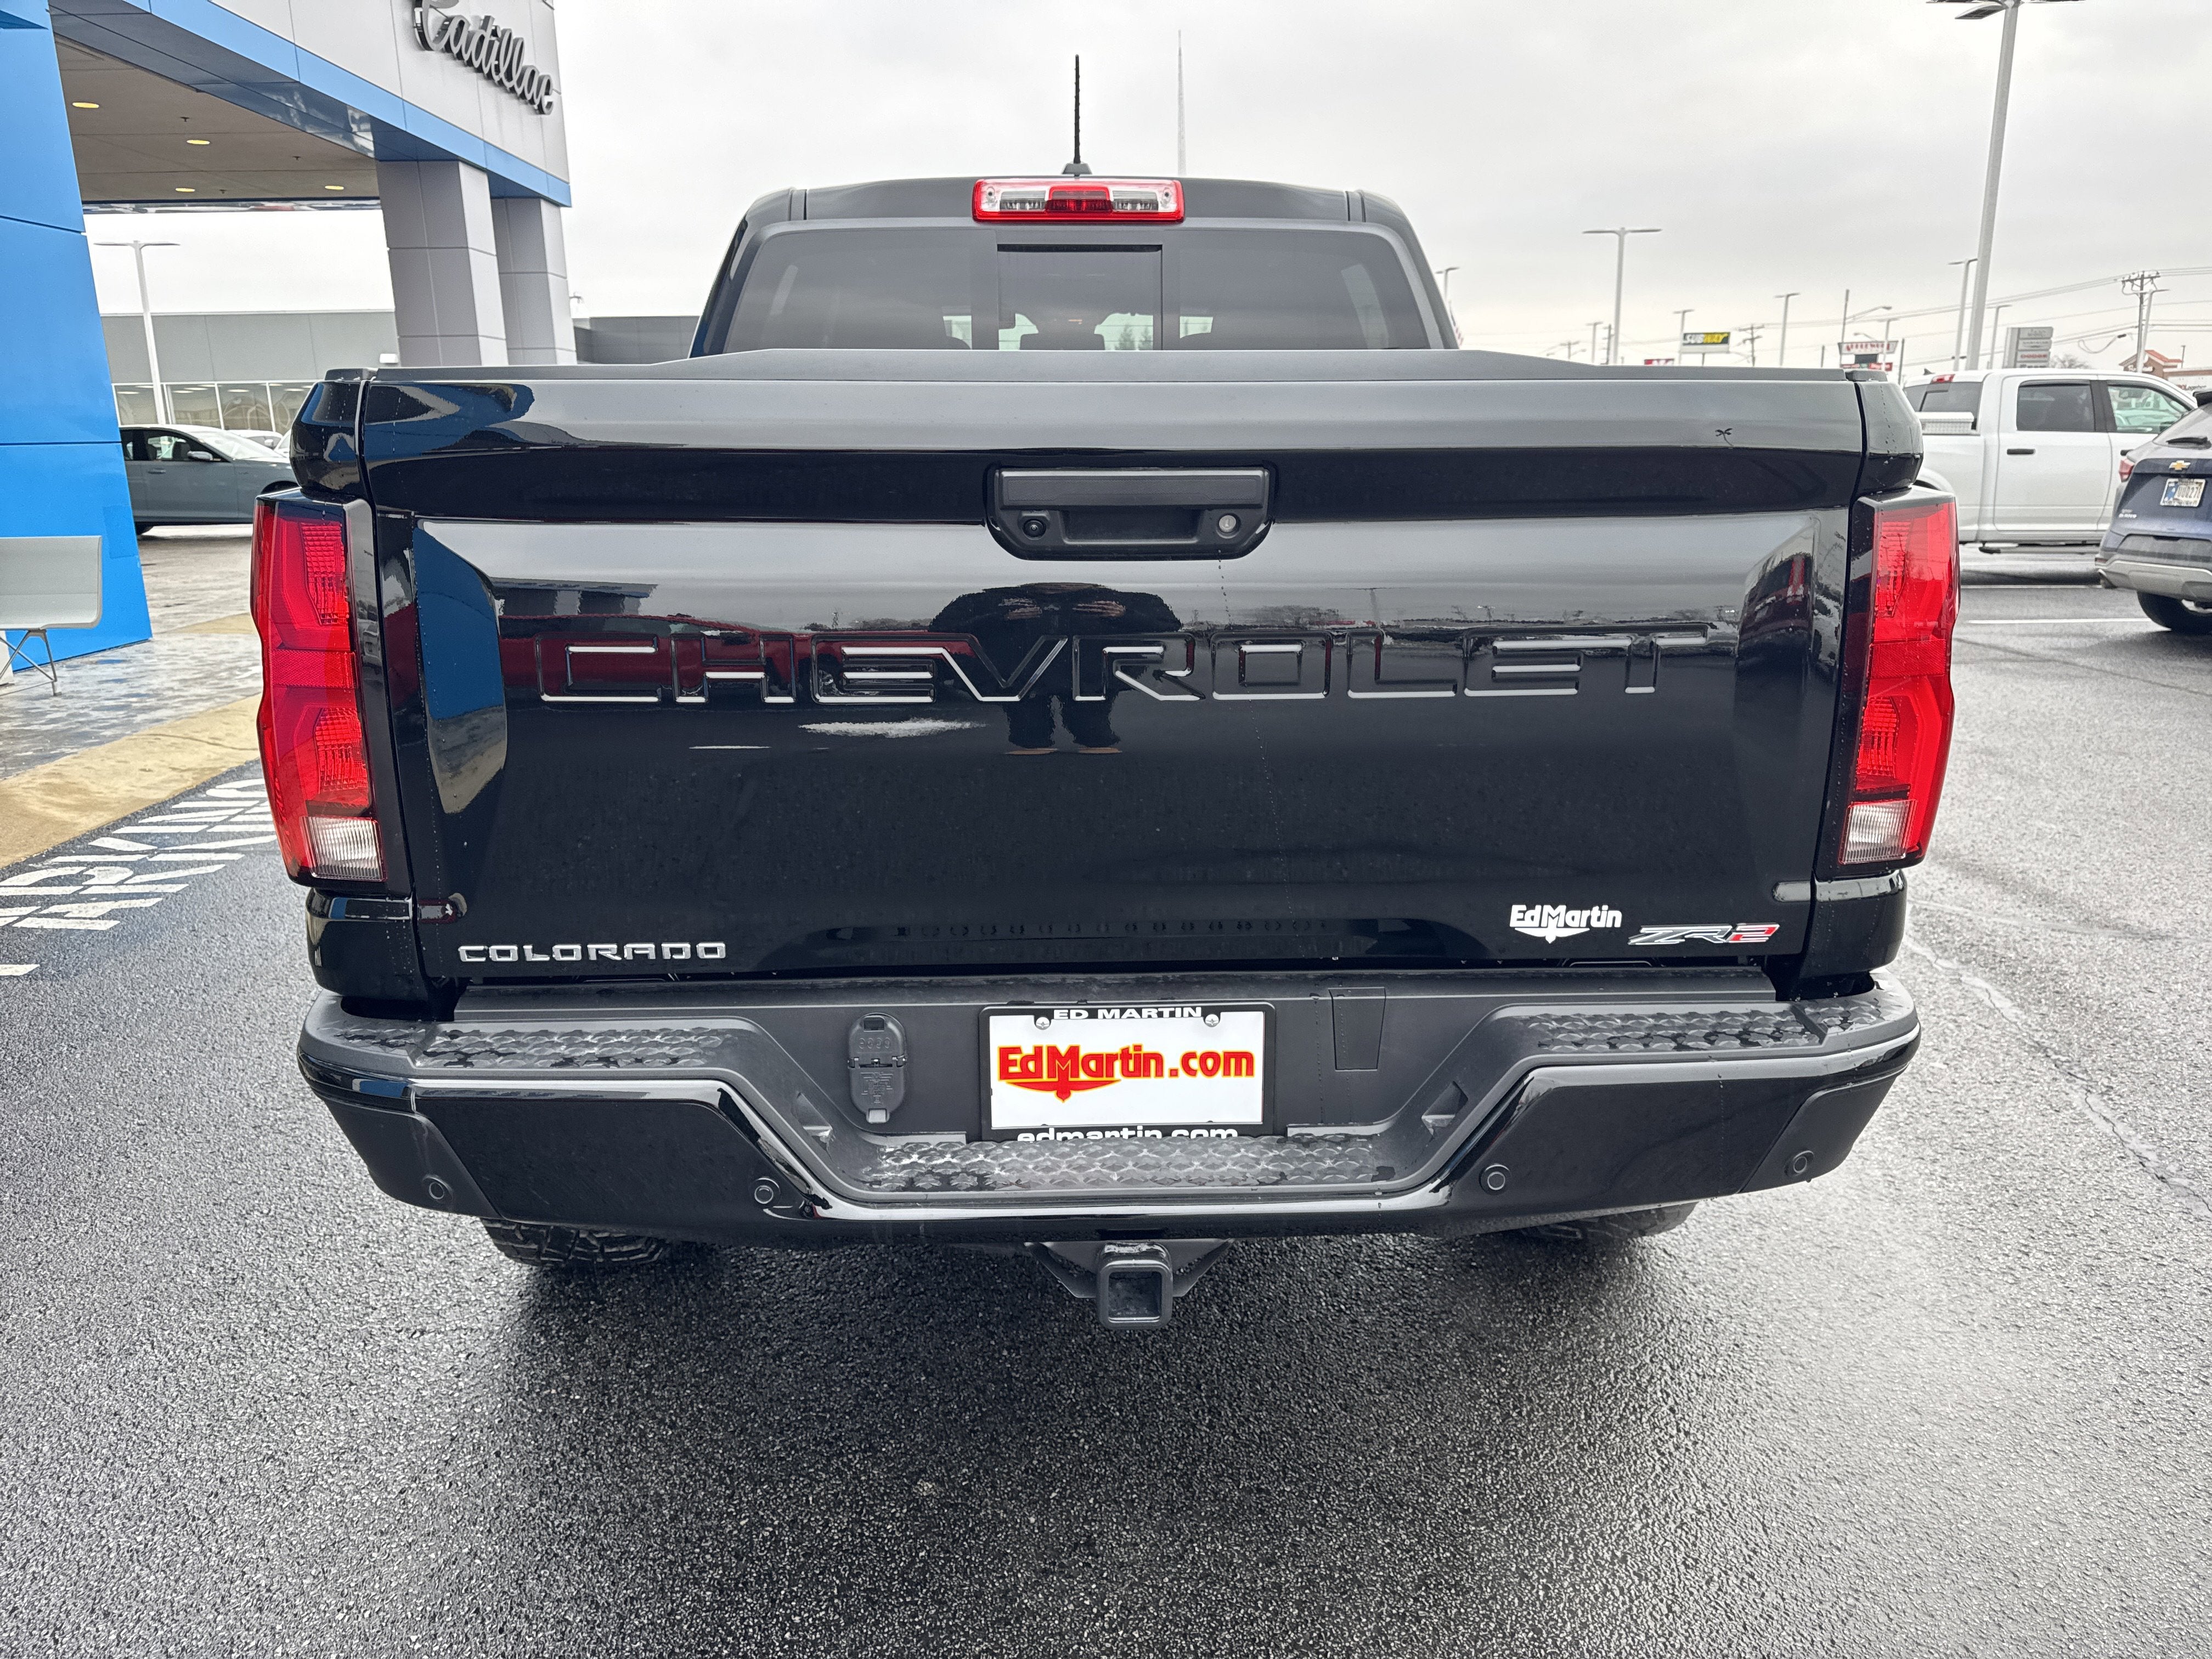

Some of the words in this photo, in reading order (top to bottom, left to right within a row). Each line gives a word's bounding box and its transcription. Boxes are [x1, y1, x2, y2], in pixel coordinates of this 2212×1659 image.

[414, 0, 554, 115] Cadillac
[1683, 333, 1728, 344] SUBWAY
[535, 622, 1710, 705] CHEVROLET
[1509, 905, 1622, 929] EdMartin
[1627, 923, 1780, 945] ZR2
[458, 941, 726, 962] COLORADO
[1053, 1009, 1088, 1019] ED
[1097, 1007, 1201, 1019] MARTIN
[997, 1043, 1255, 1083] EdMartin.com
[1017, 1125, 1238, 1142] edmartincom
